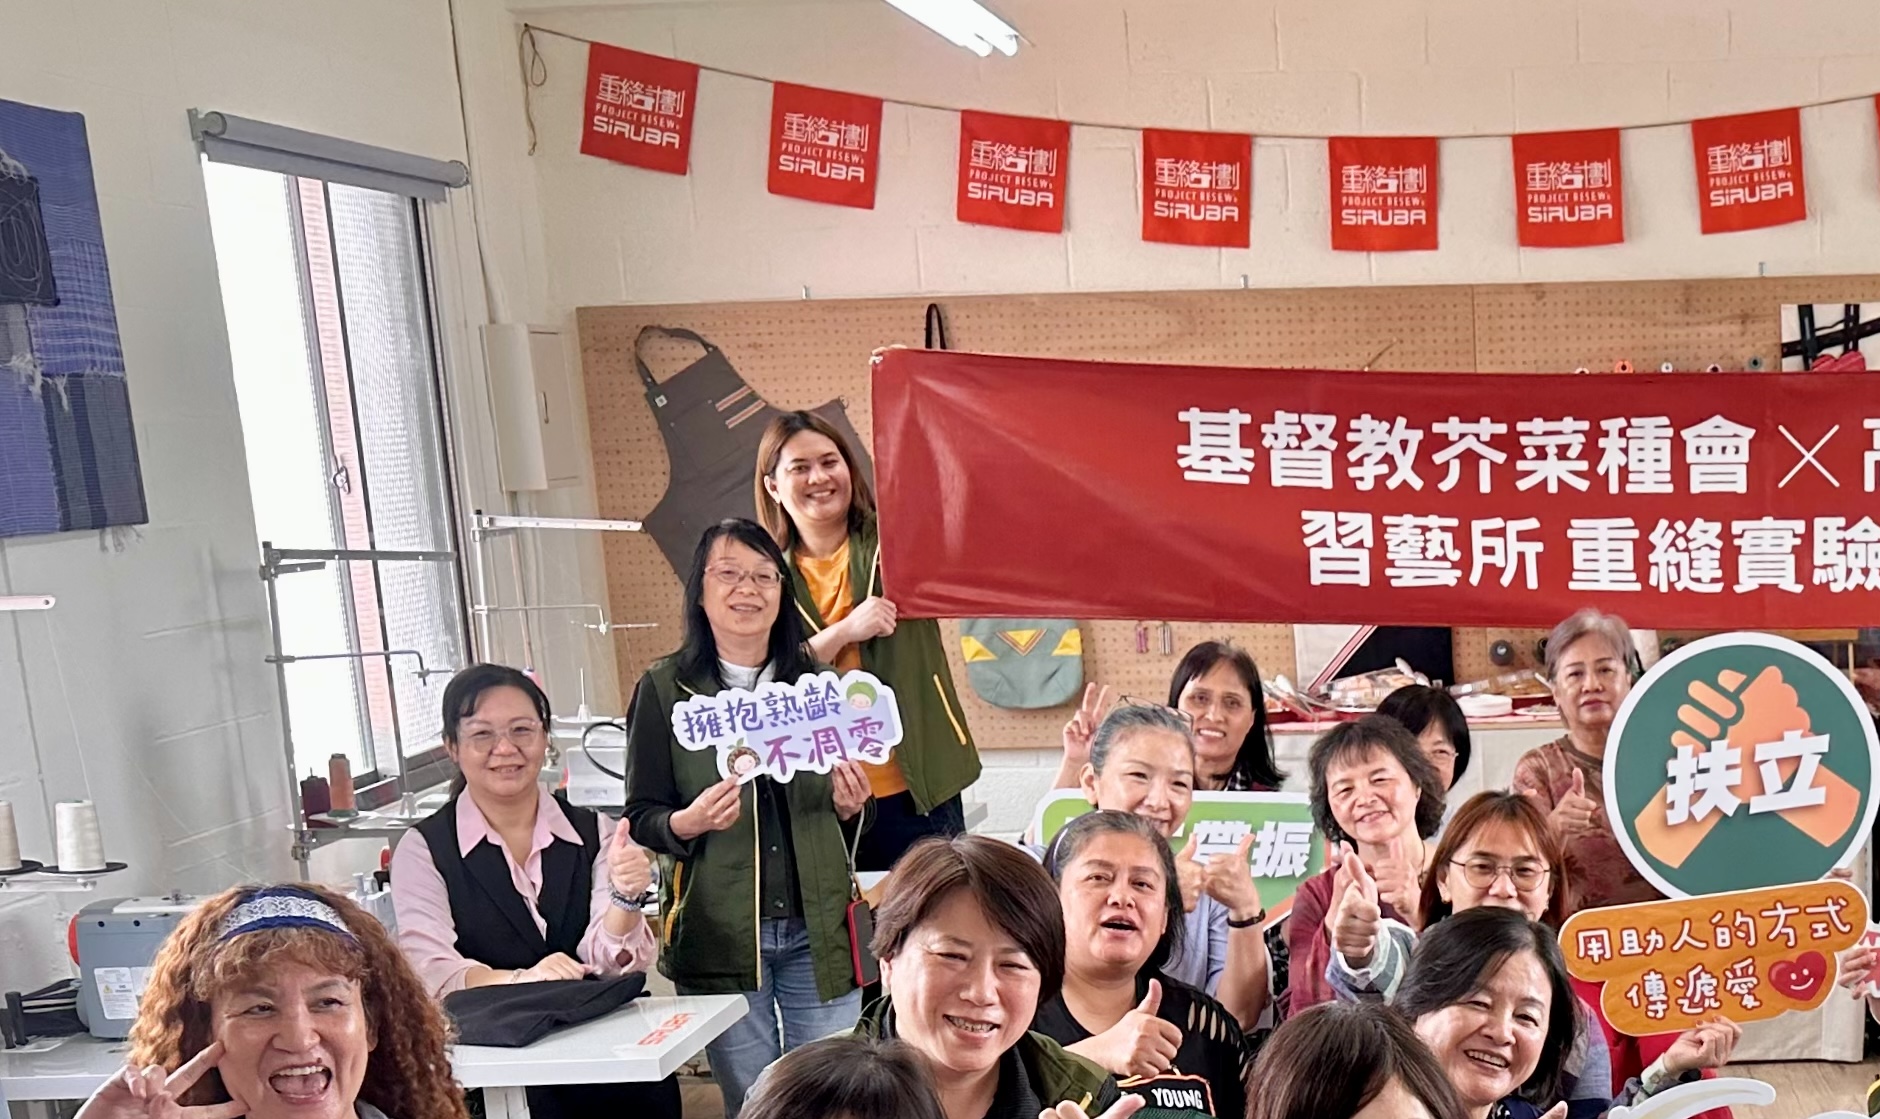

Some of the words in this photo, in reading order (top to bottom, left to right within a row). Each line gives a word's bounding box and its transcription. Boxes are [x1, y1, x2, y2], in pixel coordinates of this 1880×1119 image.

[596, 103, 638, 120] PROJECT
[782, 142, 822, 158] PROJECT
[969, 169, 1011, 184] PROJECT
[1710, 174, 1750, 188] PROJECT
[1155, 188, 1197, 200] PROJECT
[1342, 196, 1384, 206] PROJECT
[1528, 192, 1568, 203] PROJECT
[1176, 407, 1756, 495] 基督教芥菜種會
[1300, 509, 1544, 590] 習藝所
[682, 681, 842, 743] 擁抱熟齡
[764, 716, 884, 776] 不凋零
[1666, 729, 1830, 826] 扶立
[1576, 897, 1853, 963] 用助人的方式
[1625, 957, 1763, 1019] 傳遞愛
[1151, 1088, 1204, 1110] YOUNG
